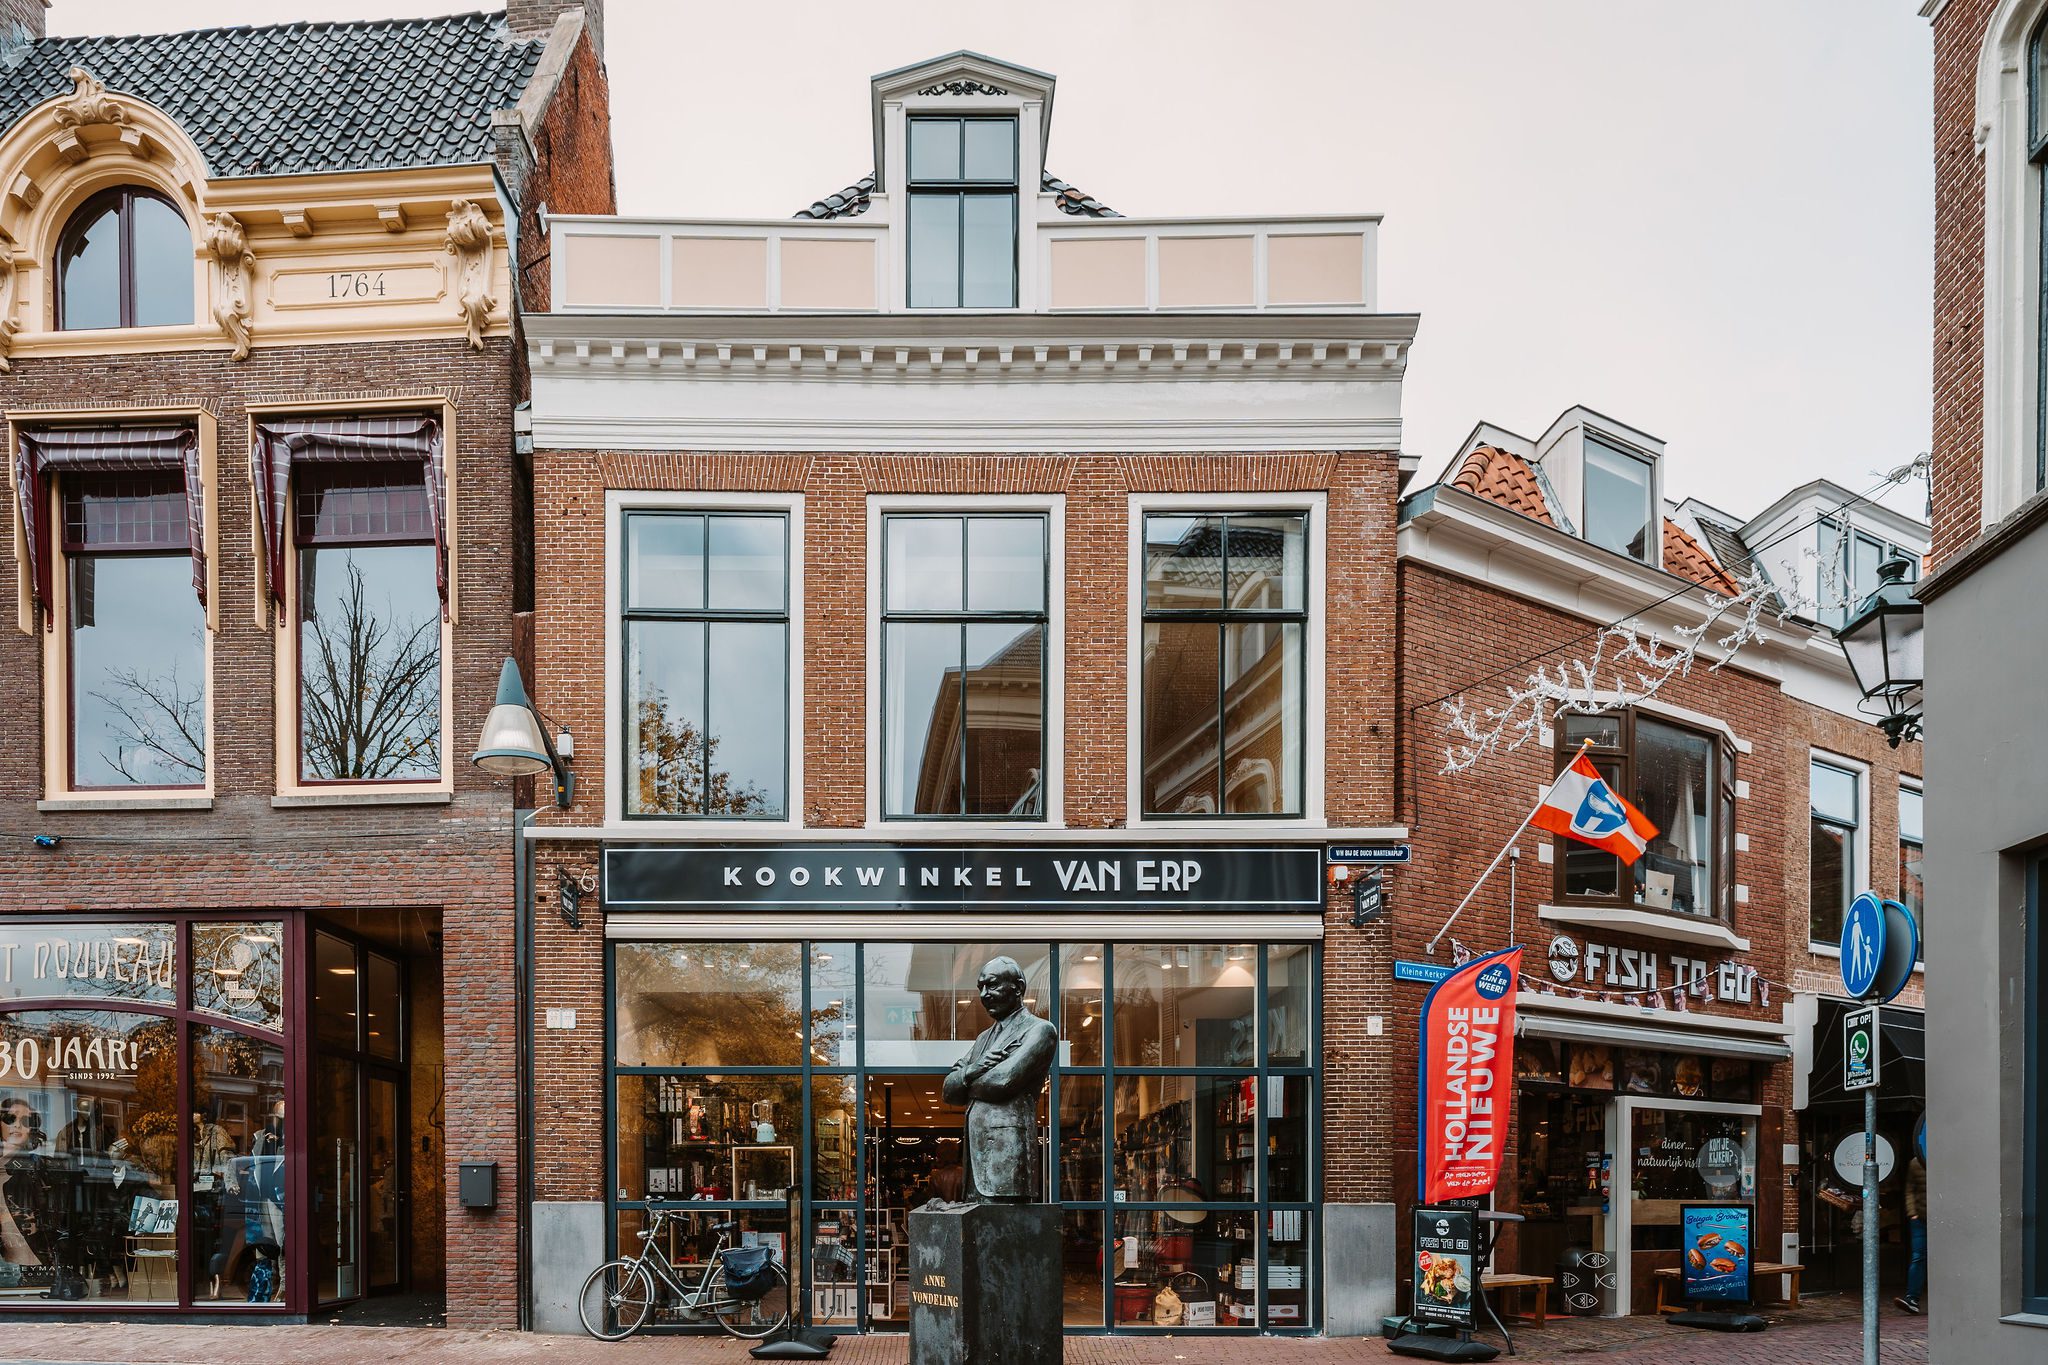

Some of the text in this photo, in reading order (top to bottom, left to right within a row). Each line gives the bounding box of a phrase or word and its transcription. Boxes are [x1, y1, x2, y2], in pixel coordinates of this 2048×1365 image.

[327, 272, 386, 298] 1764
[723, 860, 1202, 892] KOOKWINKEL VAN ERP
[33, 939, 174, 989] NOUVEAU
[1401, 966, 1423, 977] Kleine
[1493, 969, 1503, 977] ZE
[1584, 941, 1752, 1003] FISH TO GO
[1481, 973, 1508, 986] ZIJN ER
[1478, 980, 1504, 994] WEER!
[1860, 1013, 1872, 1025] OP!
[0, 1036, 138, 1080] 30 JAAR!
[69, 1072, 115, 1080] SINDS 1992
[1445, 1007, 1469, 1161] HOLLANDSE
[1466, 1007, 1500, 1161] NIEUWE
[1709, 1138, 1730, 1151] KOM JE
[1637, 1155, 1683, 1171] natuurlijk
[1709, 1150, 1734, 1166] KIJKEN?
[1472, 1176, 1490, 1186] Zee!
[1115, 1192, 1125, 1201] 43
[1686, 1214, 1713, 1225] Belegde
[1420, 1237, 1439, 1249] FISH
[1441, 1238, 1454, 1250] TO
[1456, 1239, 1469, 1251] GO
[923, 1275, 946, 1288] ANNE
[912, 1291, 959, 1308] VONDELING
